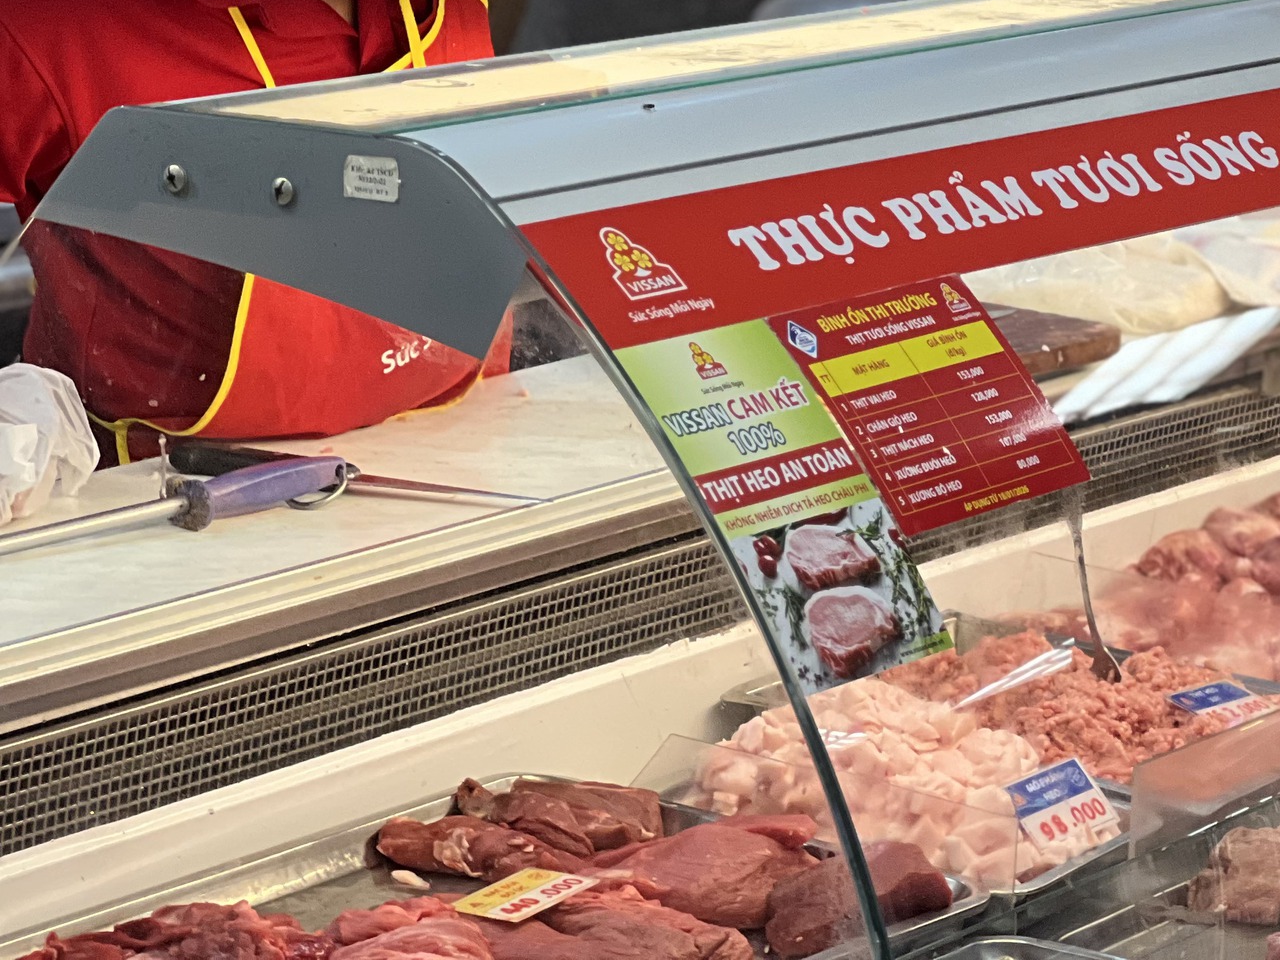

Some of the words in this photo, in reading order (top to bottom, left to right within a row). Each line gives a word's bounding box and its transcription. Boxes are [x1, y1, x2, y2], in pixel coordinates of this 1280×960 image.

[727, 203, 891, 271] THỰC
[882, 170, 1043, 240] PHẨM
[1031, 150, 1163, 210] TƯƠI
[1153, 130, 1280, 186] SỐNG
[626, 274, 677, 294] VISSAN
[816, 311, 850, 333] BÌNH
[846, 305, 866, 326] ỔN
[864, 301, 892, 321] THỊ
[884, 292, 938, 319] TRƯỜNG
[844, 332, 866, 346] THỊT
[864, 327, 885, 341] TƯƠI
[884, 320, 909, 337] SỐNG
[907, 315, 936, 331] VISSAN
[700, 366, 726, 379] VISSAN
[820, 374, 831, 384] TT
[661, 402, 733, 437] VISSAN
[727, 392, 775, 420] CAM
[769, 378, 808, 409] KẾT
[870, 394, 883, 406] VAI
[881, 389, 897, 402] HEO
[855, 425, 864, 436] 2
[901, 411, 918, 424] HEO
[727, 421, 787, 455] 100%
[869, 448, 878, 458] 3
[918, 433, 934, 446] HEO
[939, 454, 957, 467] HEO
[703, 475, 745, 503] THỊT
[743, 466, 781, 493] HEO
[779, 459, 809, 483] AN
[801, 446, 853, 476] TOÀN
[898, 495, 906, 506] 5
[945, 479, 963, 492] HEO
[724, 513, 756, 531] KHÔNG
[814, 492, 831, 506] HEO
[855, 482, 870, 495] PHI
